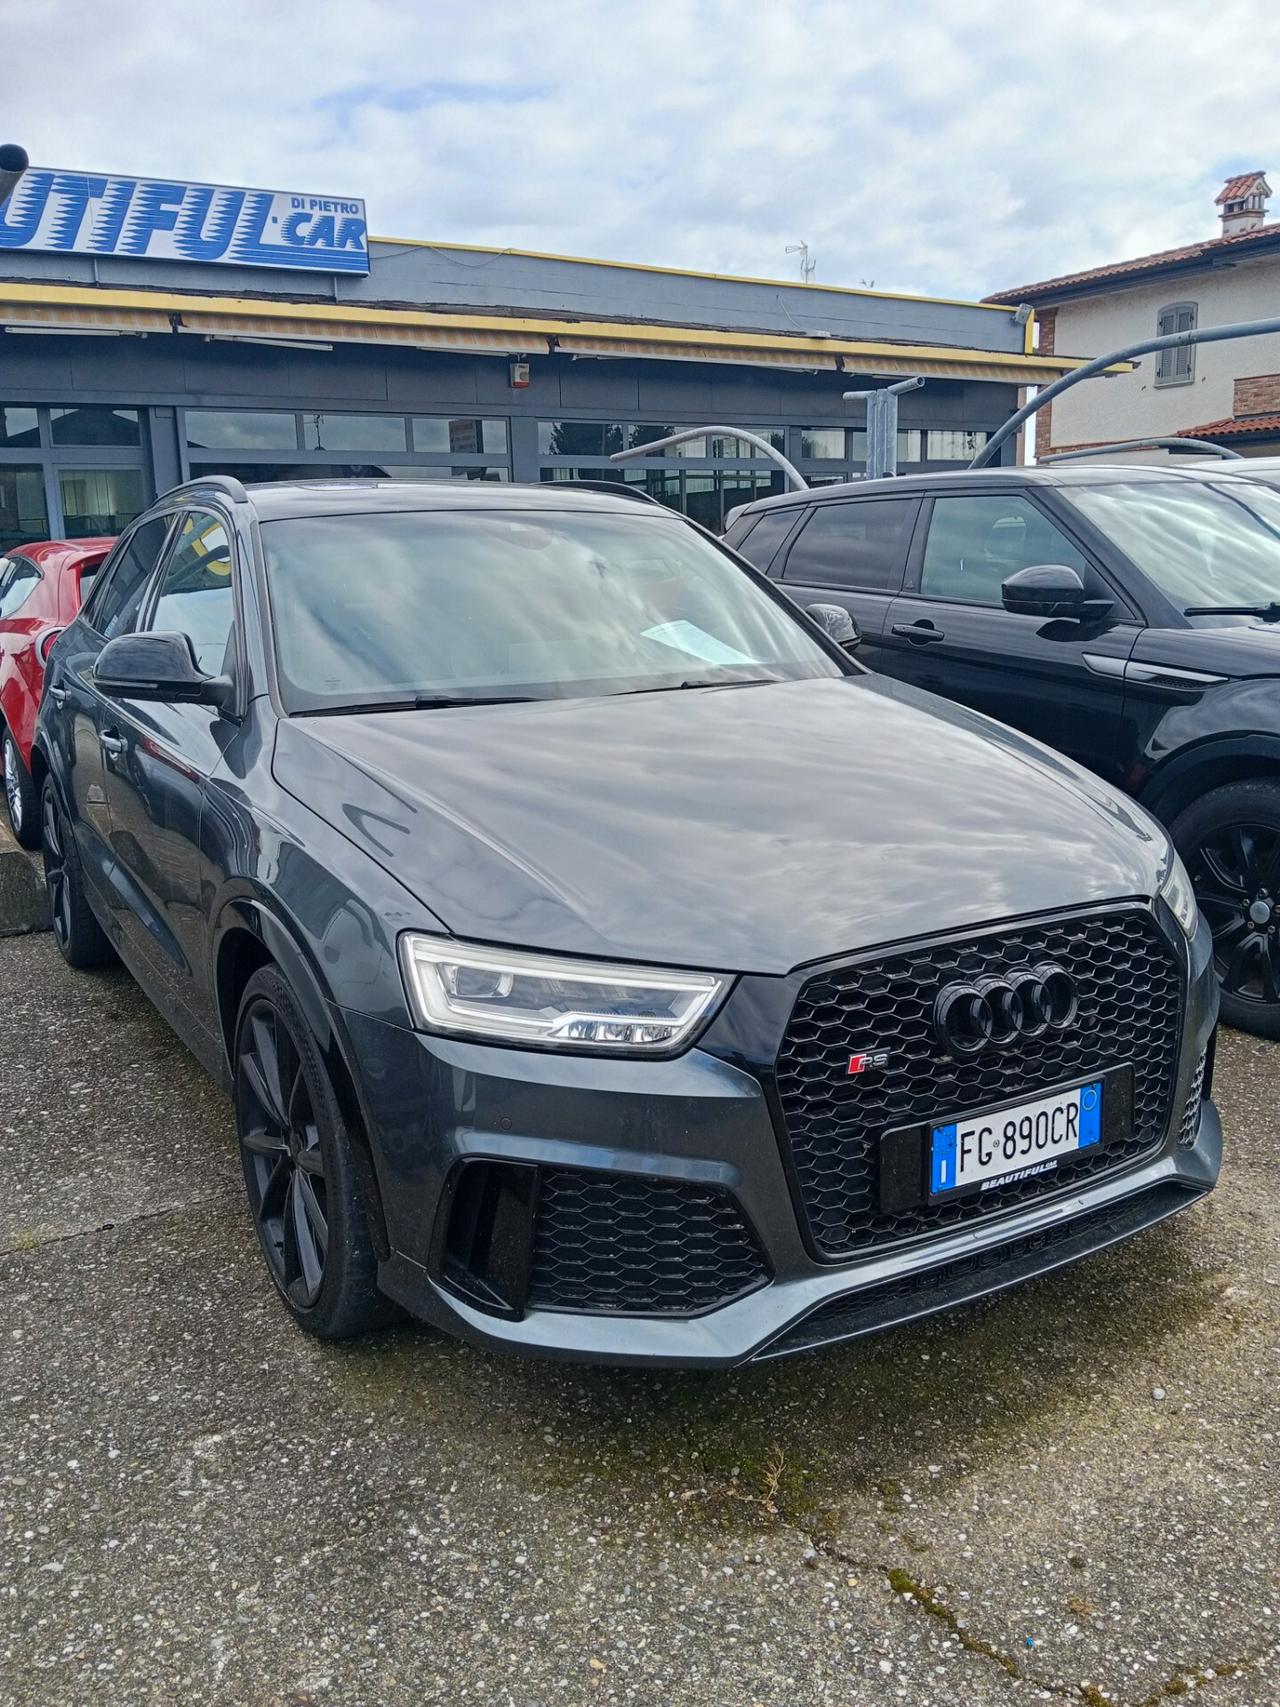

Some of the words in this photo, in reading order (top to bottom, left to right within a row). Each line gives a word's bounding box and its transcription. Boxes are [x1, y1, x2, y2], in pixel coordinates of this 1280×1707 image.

[291, 197, 305, 209] DI
[309, 199, 359, 215] PIETRO
[280, 212, 365, 250] CAR
[849, 1053, 888, 1074] RS
[960, 1127, 993, 1173] FG
[1002, 1102, 1079, 1160] 890CR
[980, 1165, 1047, 1191] BEAUTIFUL
